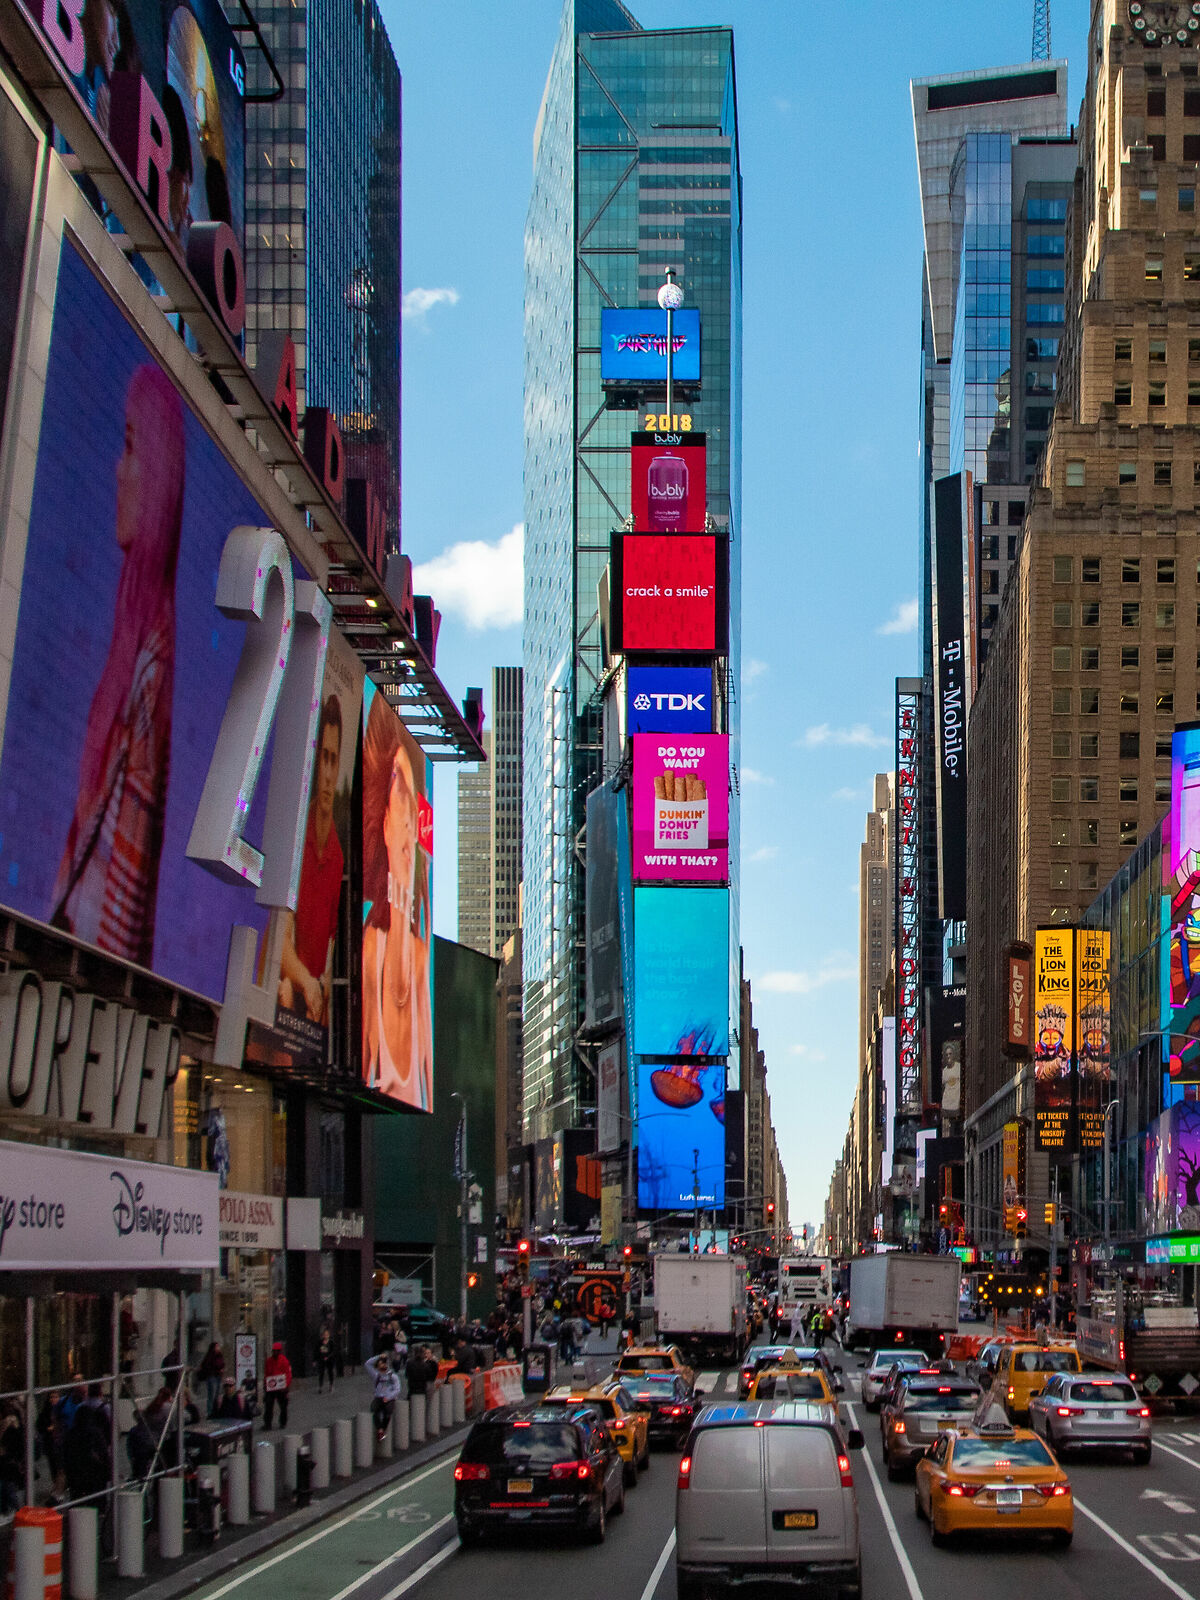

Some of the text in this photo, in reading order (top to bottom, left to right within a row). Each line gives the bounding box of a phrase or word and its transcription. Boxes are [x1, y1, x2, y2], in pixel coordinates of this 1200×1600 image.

[645, 414, 692, 431] 2018
[626, 586, 660, 598] crack
[664, 588, 672, 598] a
[650, 693, 706, 711] TDK
[657, 747, 705, 757] DO YOU
[663, 758, 699, 769] WANT
[659, 810, 705, 820] DUNKIN'
[659, 820, 698, 830] DONUT
[659, 830, 689, 841] FRIES
[644, 855, 718, 867] WITH THAT?
[1043, 946, 1063, 955] THE
[1040, 958, 1066, 973] LION
[1038, 974, 1070, 993] KING
[1037, 1112, 1069, 1120] GET TICKETS
[1041, 1138, 1064, 1146] THEATRE
[19, 1194, 65, 1229] store
[110, 1171, 202, 1256] Disney store
[219, 1197, 246, 1224] POLO
